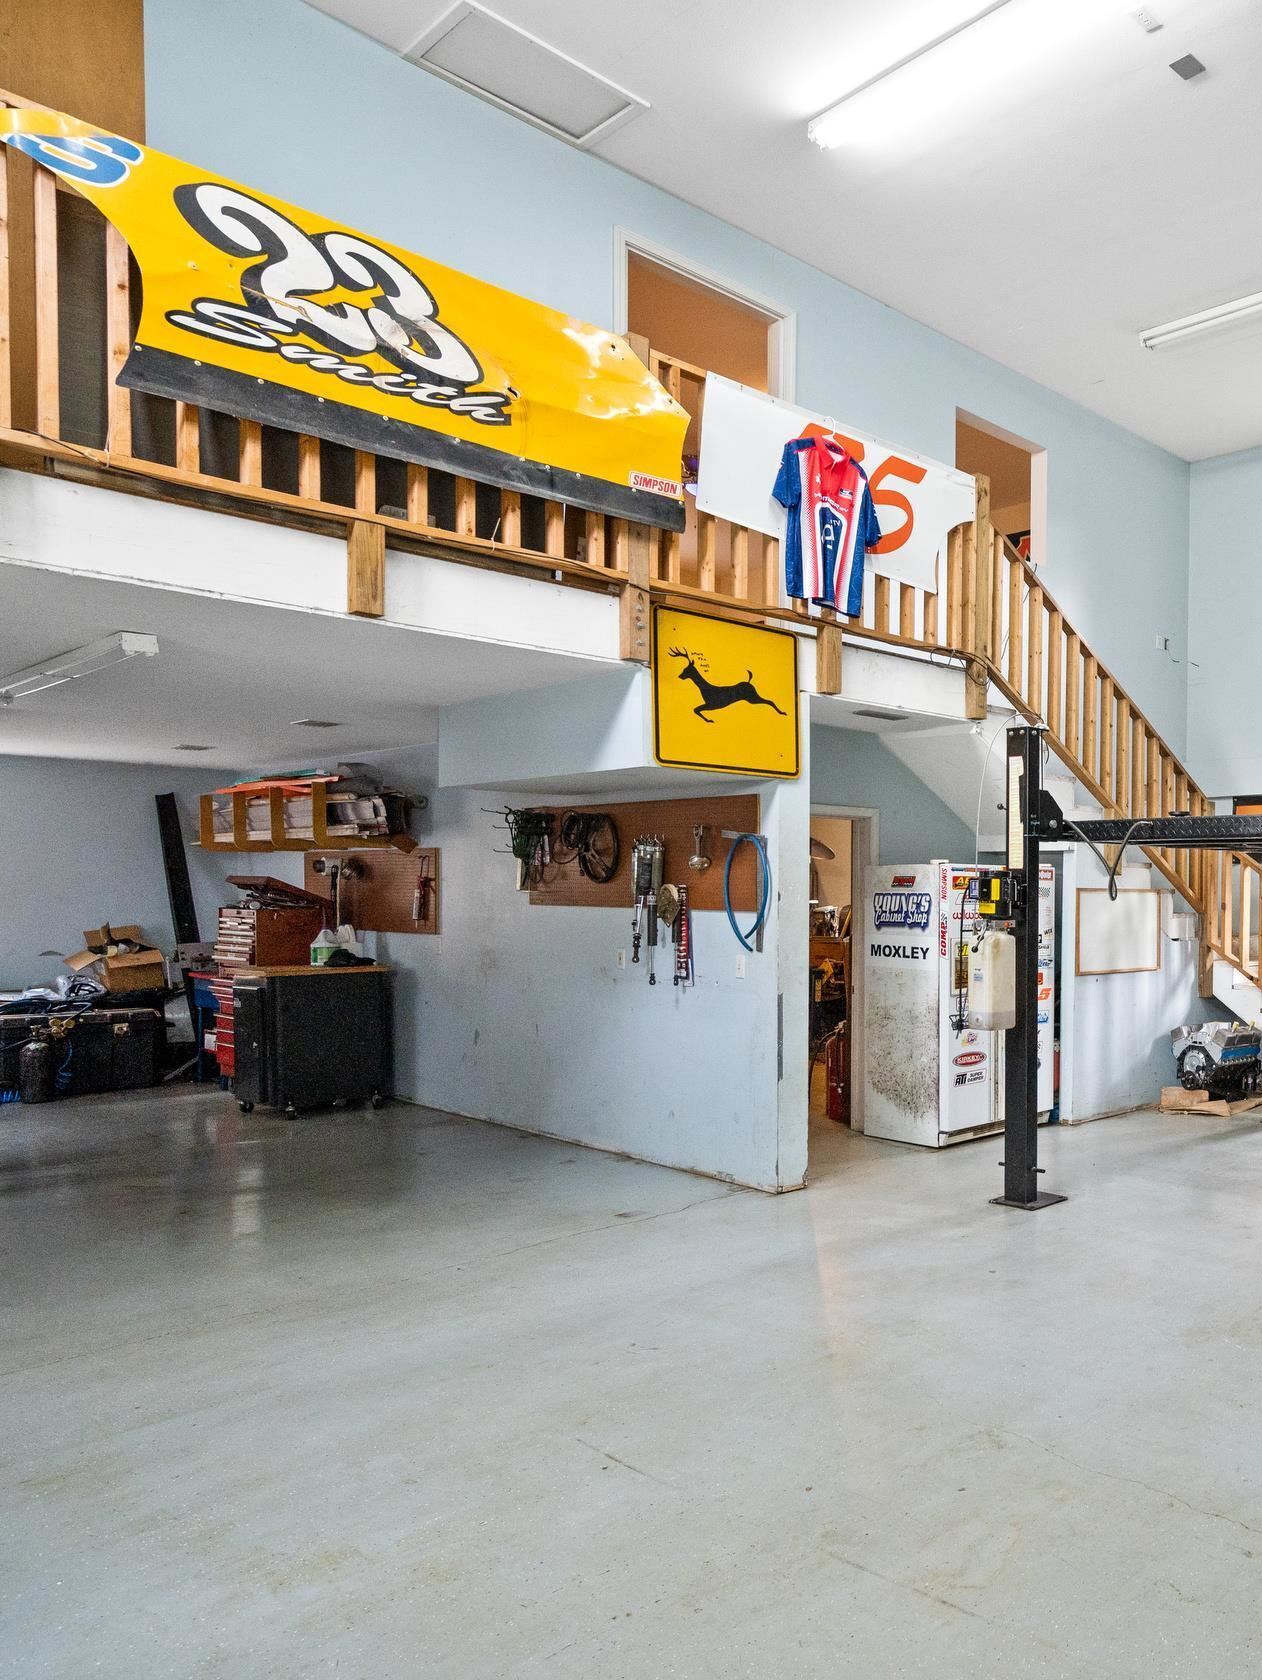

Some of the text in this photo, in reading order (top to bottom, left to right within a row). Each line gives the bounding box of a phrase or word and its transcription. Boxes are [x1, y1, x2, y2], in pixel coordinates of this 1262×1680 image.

[173, 182, 484, 384] 23
[164, 297, 513, 426] Smith
[632, 474, 678, 495] SIMPSON
[874, 894, 931, 912] YOUNG'S
[875, 909, 905, 925] Cabinet
[906, 909, 928, 926] Shop
[870, 944, 930, 960] MOXLEY
